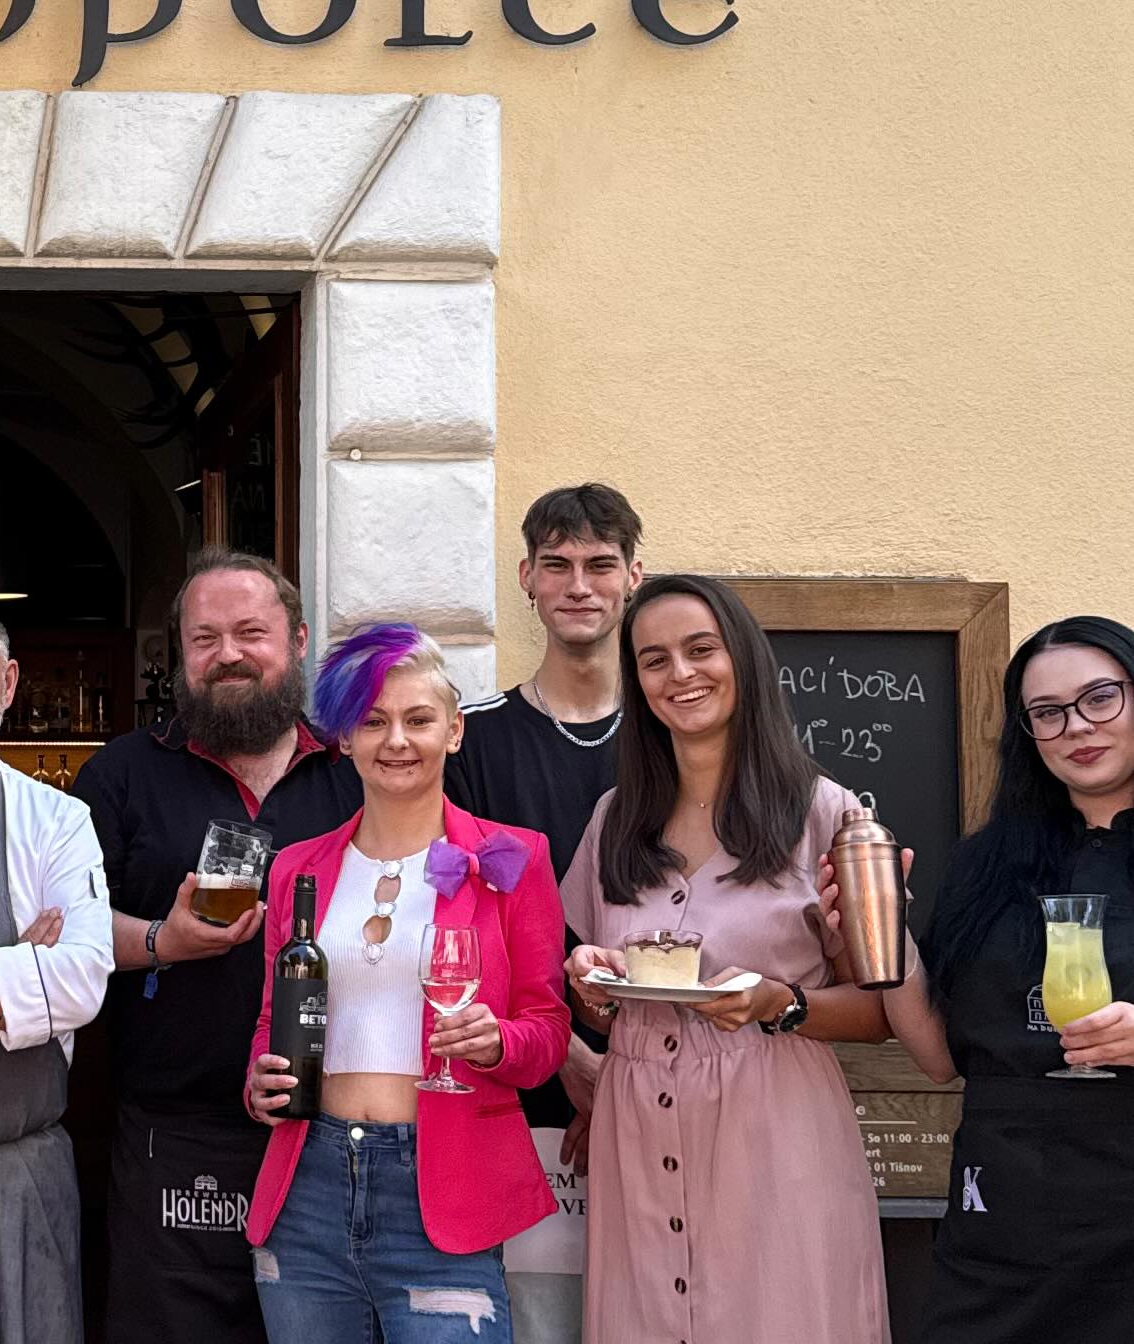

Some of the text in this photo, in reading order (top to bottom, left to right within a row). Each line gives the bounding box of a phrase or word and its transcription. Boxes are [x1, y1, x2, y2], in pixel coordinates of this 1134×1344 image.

[837, 668, 926, 703] DOBA
[884, 1134, 912, 1143] 11:00
[921, 1134, 949, 1143] 23:00
[889, 1162, 923, 1172] Tišnov
